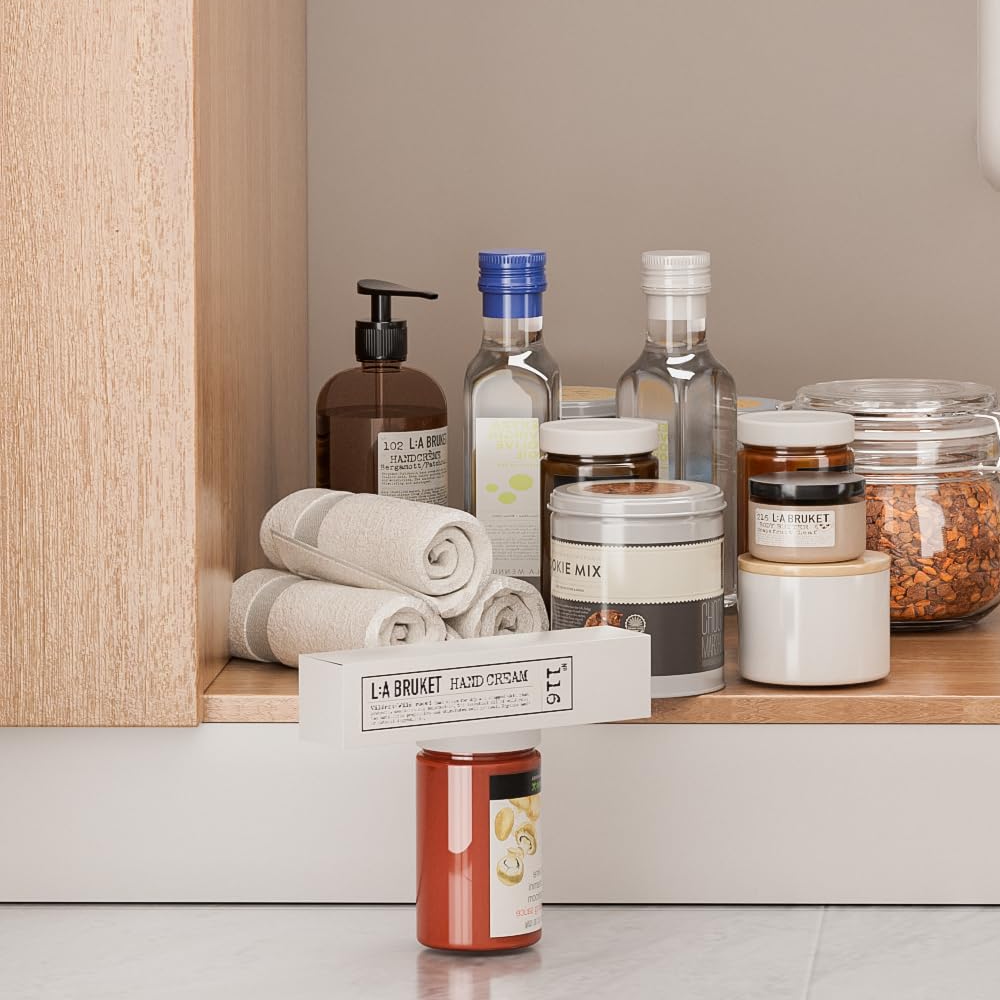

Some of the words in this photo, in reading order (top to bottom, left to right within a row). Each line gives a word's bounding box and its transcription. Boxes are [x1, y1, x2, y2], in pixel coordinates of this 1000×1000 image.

[383, 441, 404, 451] 102
[409, 436, 424, 450] L:A
[772, 512, 786, 523] L:A
[787, 513, 830, 523] BRUKET
[552, 558, 571, 575] OKIE
[574, 564, 601, 578] MIX
[371, 681, 390, 700] L:A
[394, 675, 442, 698] BRUKET
[450, 674, 484, 690] HAND
[486, 669, 528, 686] CREAM
[546, 666, 561, 705] 116
